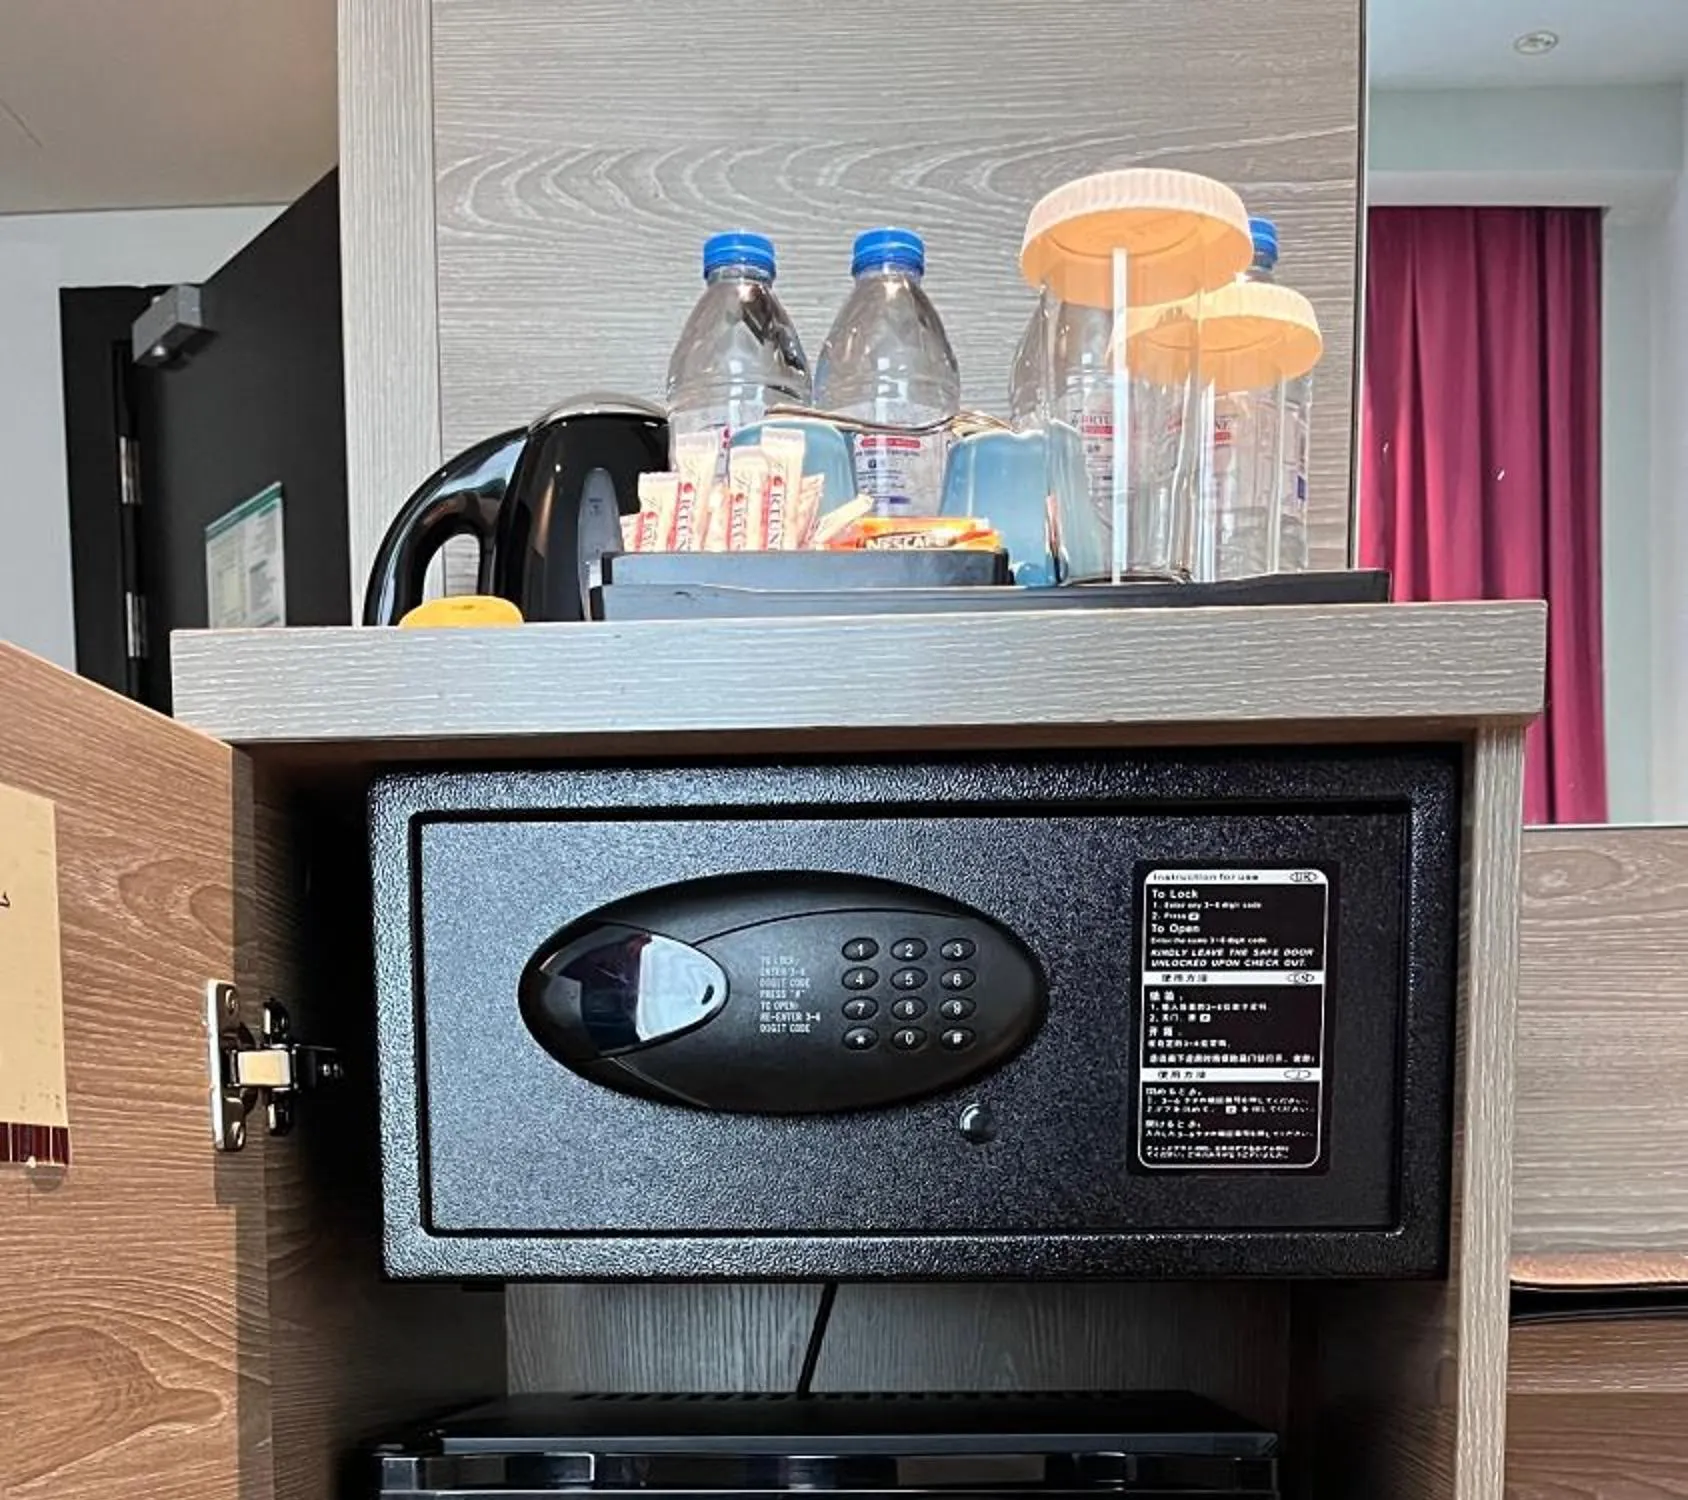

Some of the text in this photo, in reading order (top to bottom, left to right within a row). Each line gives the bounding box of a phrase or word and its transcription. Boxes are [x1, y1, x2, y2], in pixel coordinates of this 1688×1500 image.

[1219, 873, 1235, 881] for
[1152, 889, 1199, 899] To Lock
[1151, 923, 1200, 934] To Open
[1151, 948, 1314, 957] KINDLY LEAVE THE SAFE DOOR
[1151, 959, 1207, 968] UNLOCKED
[1211, 959, 1240, 968] UPON
[1243, 959, 1279, 968] CHECK
